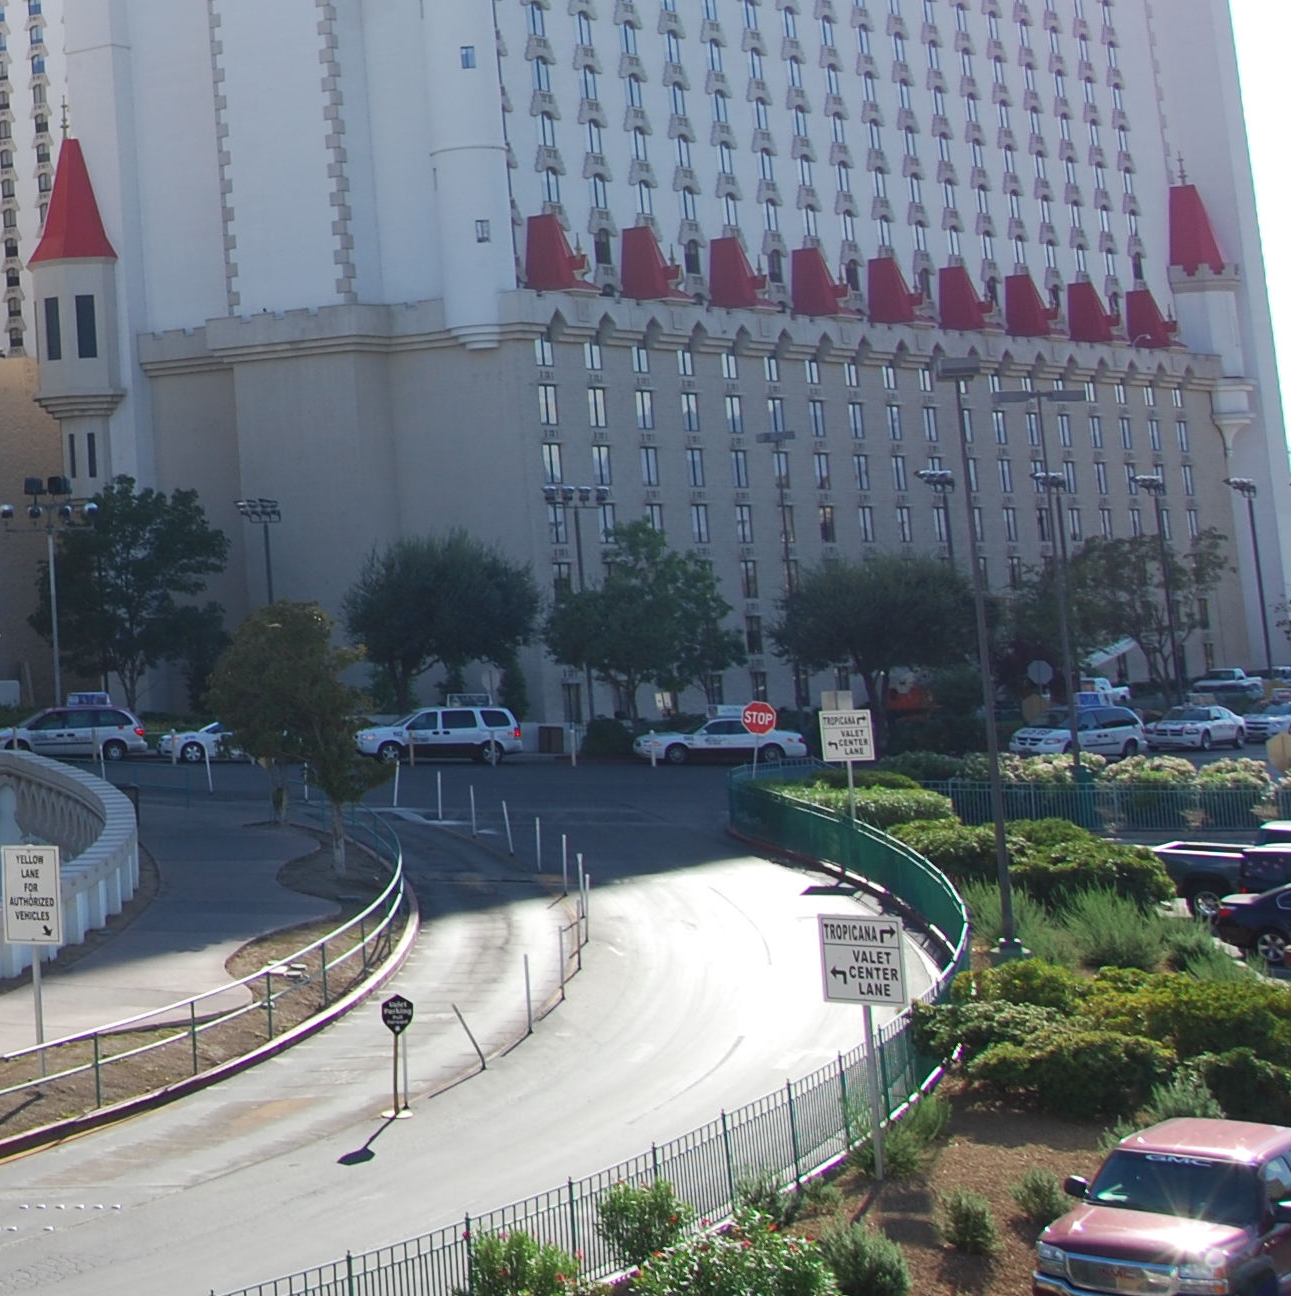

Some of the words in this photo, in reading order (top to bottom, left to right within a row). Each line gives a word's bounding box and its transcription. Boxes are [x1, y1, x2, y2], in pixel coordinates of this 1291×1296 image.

[744, 710, 773, 725] STOP
[822, 716, 856, 725] TROPICANA
[840, 729, 864, 737] VALET
[838, 738, 868, 747] CENTER
[844, 747, 864, 755] LANE
[16, 855, 44, 865] YELLOW
[21, 868, 40, 879] LANE
[24, 882, 39, 893] FOR
[9, 896, 55, 907] AUTHORIZED
[15, 910, 50, 921] VEHICLES
[823, 923, 878, 942] TROPICANA
[852, 949, 892, 965] VALET
[849, 965, 899, 982] CENTER
[859, 982, 892, 997] LANE
[384, 1007, 412, 1016] Parking
[1145, 1154, 1212, 1168] GMC
